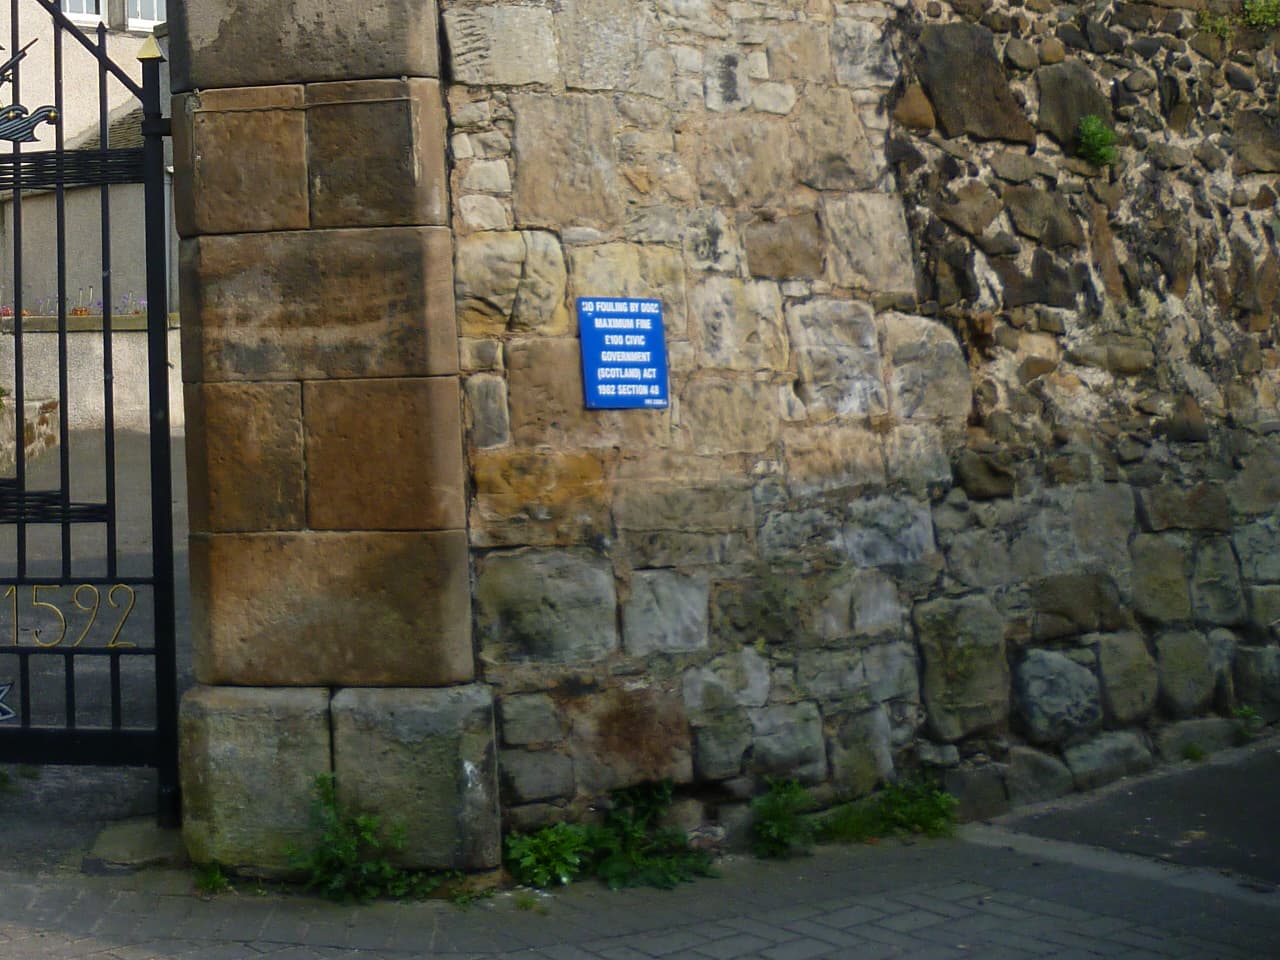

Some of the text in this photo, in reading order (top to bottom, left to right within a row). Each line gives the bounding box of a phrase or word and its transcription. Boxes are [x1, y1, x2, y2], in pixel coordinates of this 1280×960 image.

[596, 302, 628, 312] FOULING
[630, 302, 639, 312] BY
[594, 318, 652, 329] MAXIMUM FINE
[625, 335, 645, 345] CIVIC
[601, 351, 651, 362] GOVERNMENT
[597, 368, 657, 380] (SCOTLAND) ACT
[618, 385, 648, 395] SECTION
[5, 584, 137, 648] 1592
